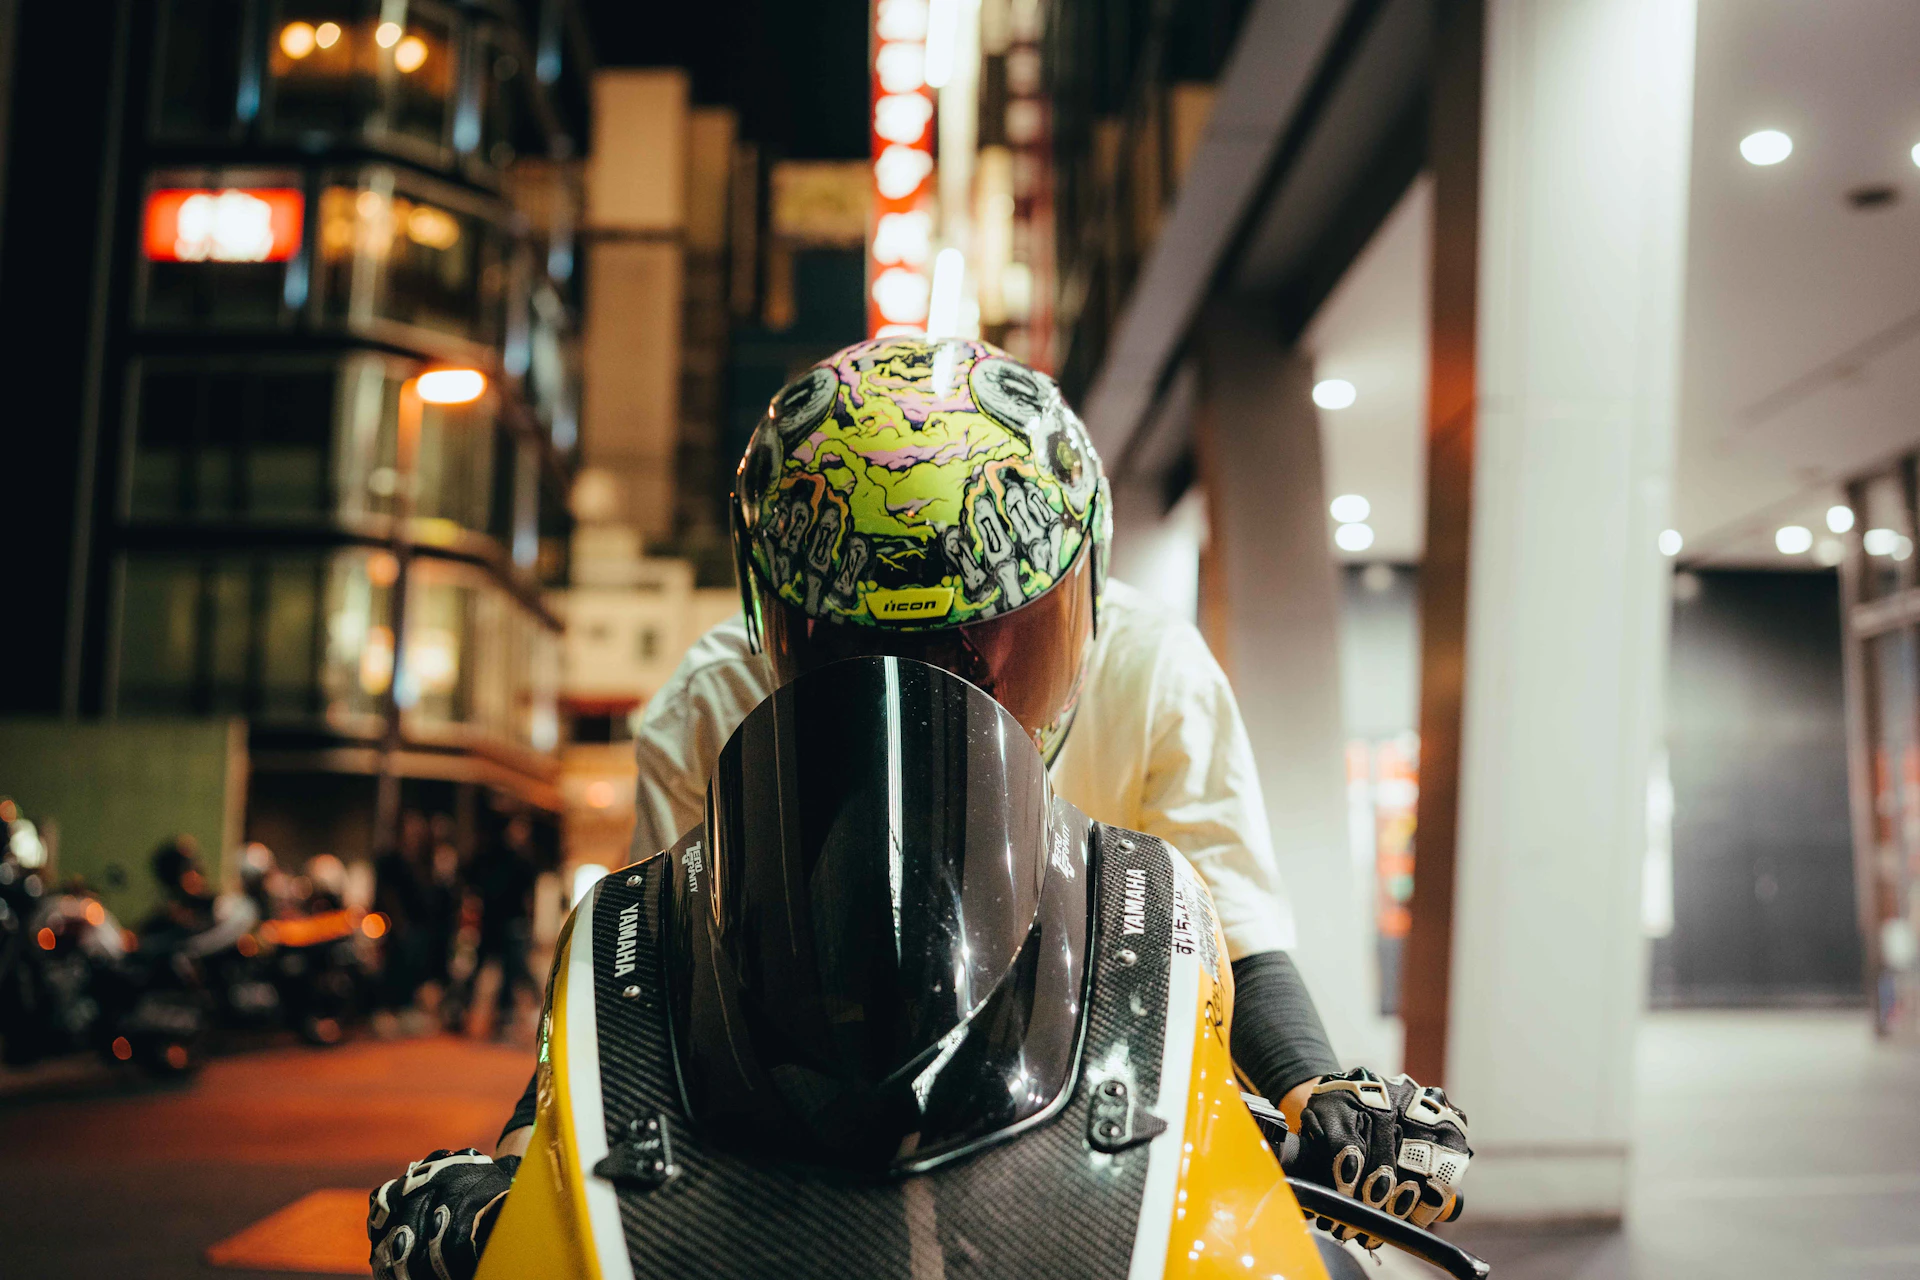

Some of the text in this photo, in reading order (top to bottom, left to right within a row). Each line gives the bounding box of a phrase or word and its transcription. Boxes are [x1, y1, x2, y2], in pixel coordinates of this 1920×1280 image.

[686, 841, 703, 873] ZERO
[1122, 868, 1146, 935] YAMAHA
[614, 902, 640, 978] YAMAHA
